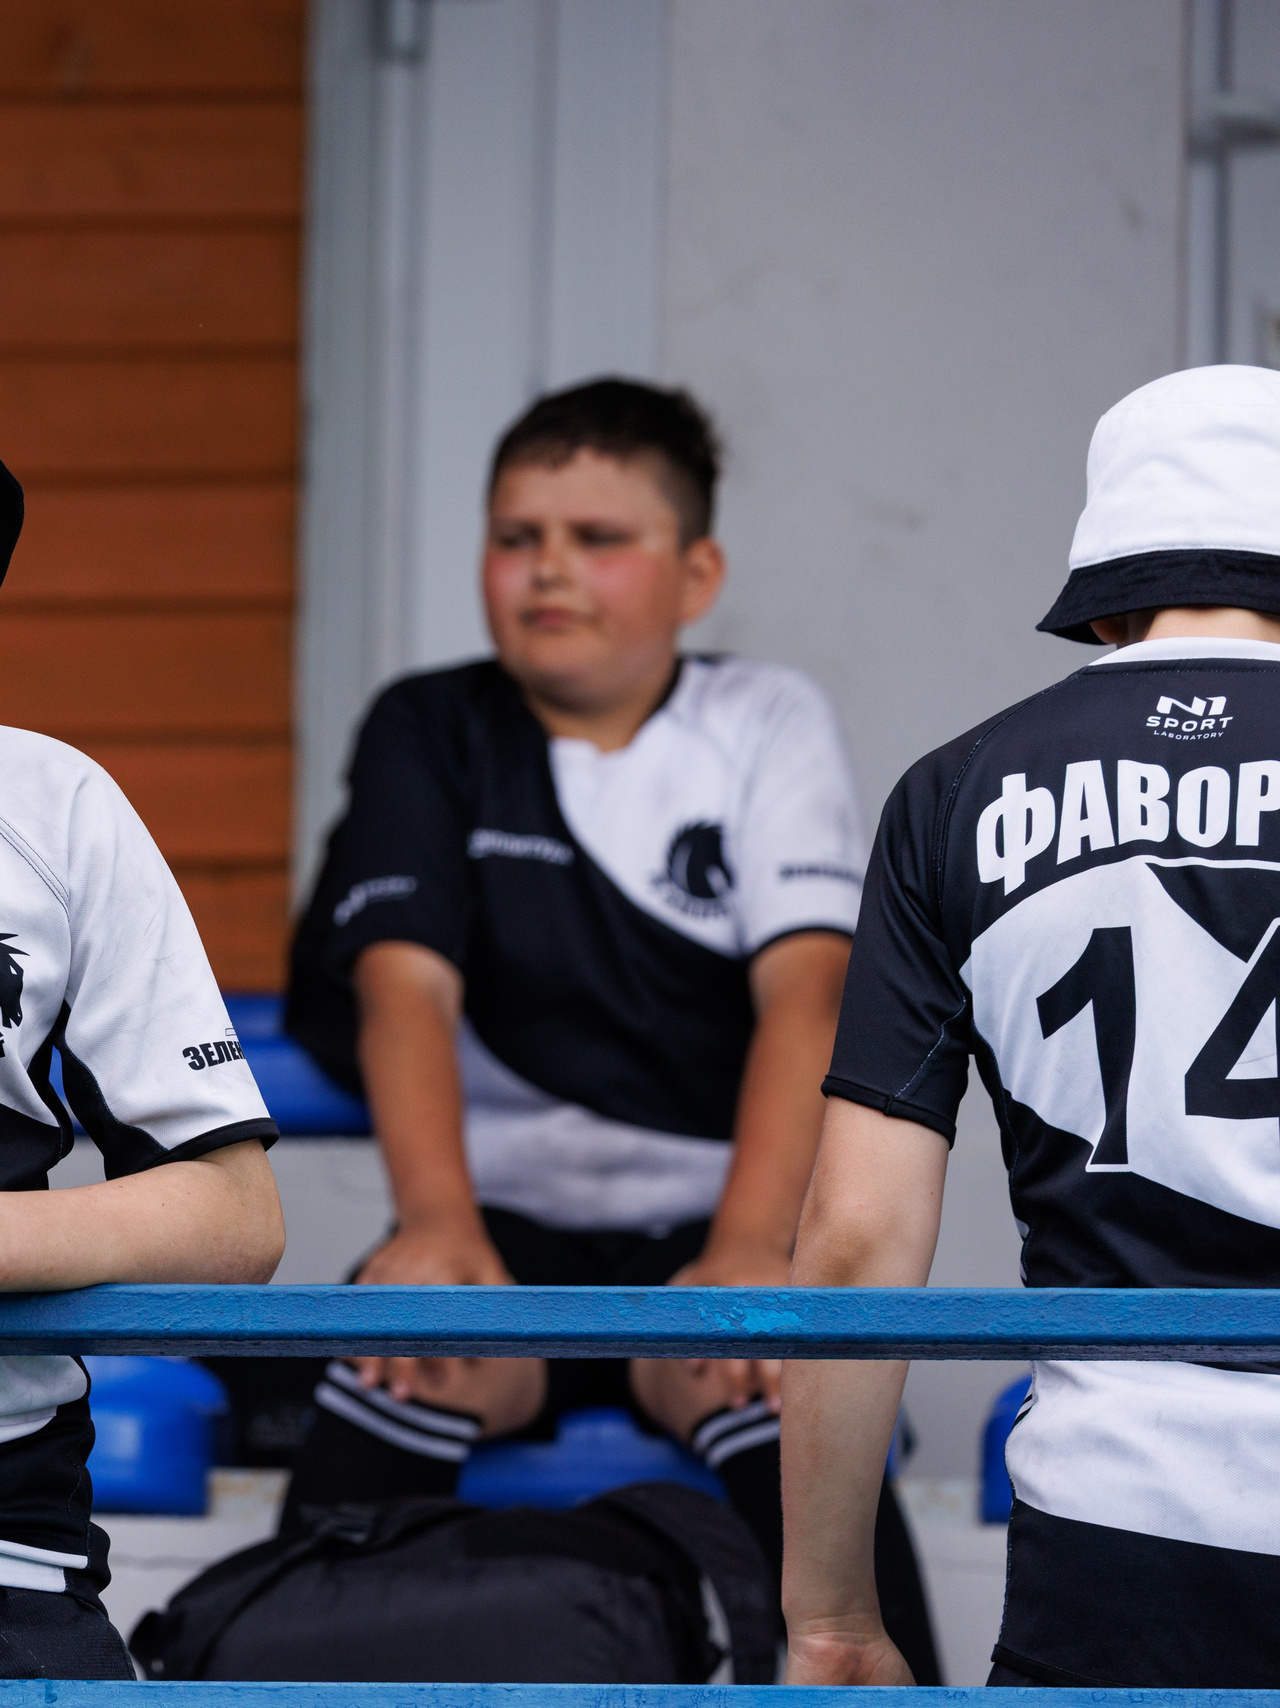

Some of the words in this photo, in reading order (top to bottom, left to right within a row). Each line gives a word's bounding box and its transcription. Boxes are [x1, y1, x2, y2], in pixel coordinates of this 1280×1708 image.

[1156, 695, 1227, 717] N1
[1145, 715, 1234, 732] SPORT
[1153, 730, 1224, 740] LABORATORY
[1036, 925, 1280, 1166] 14
